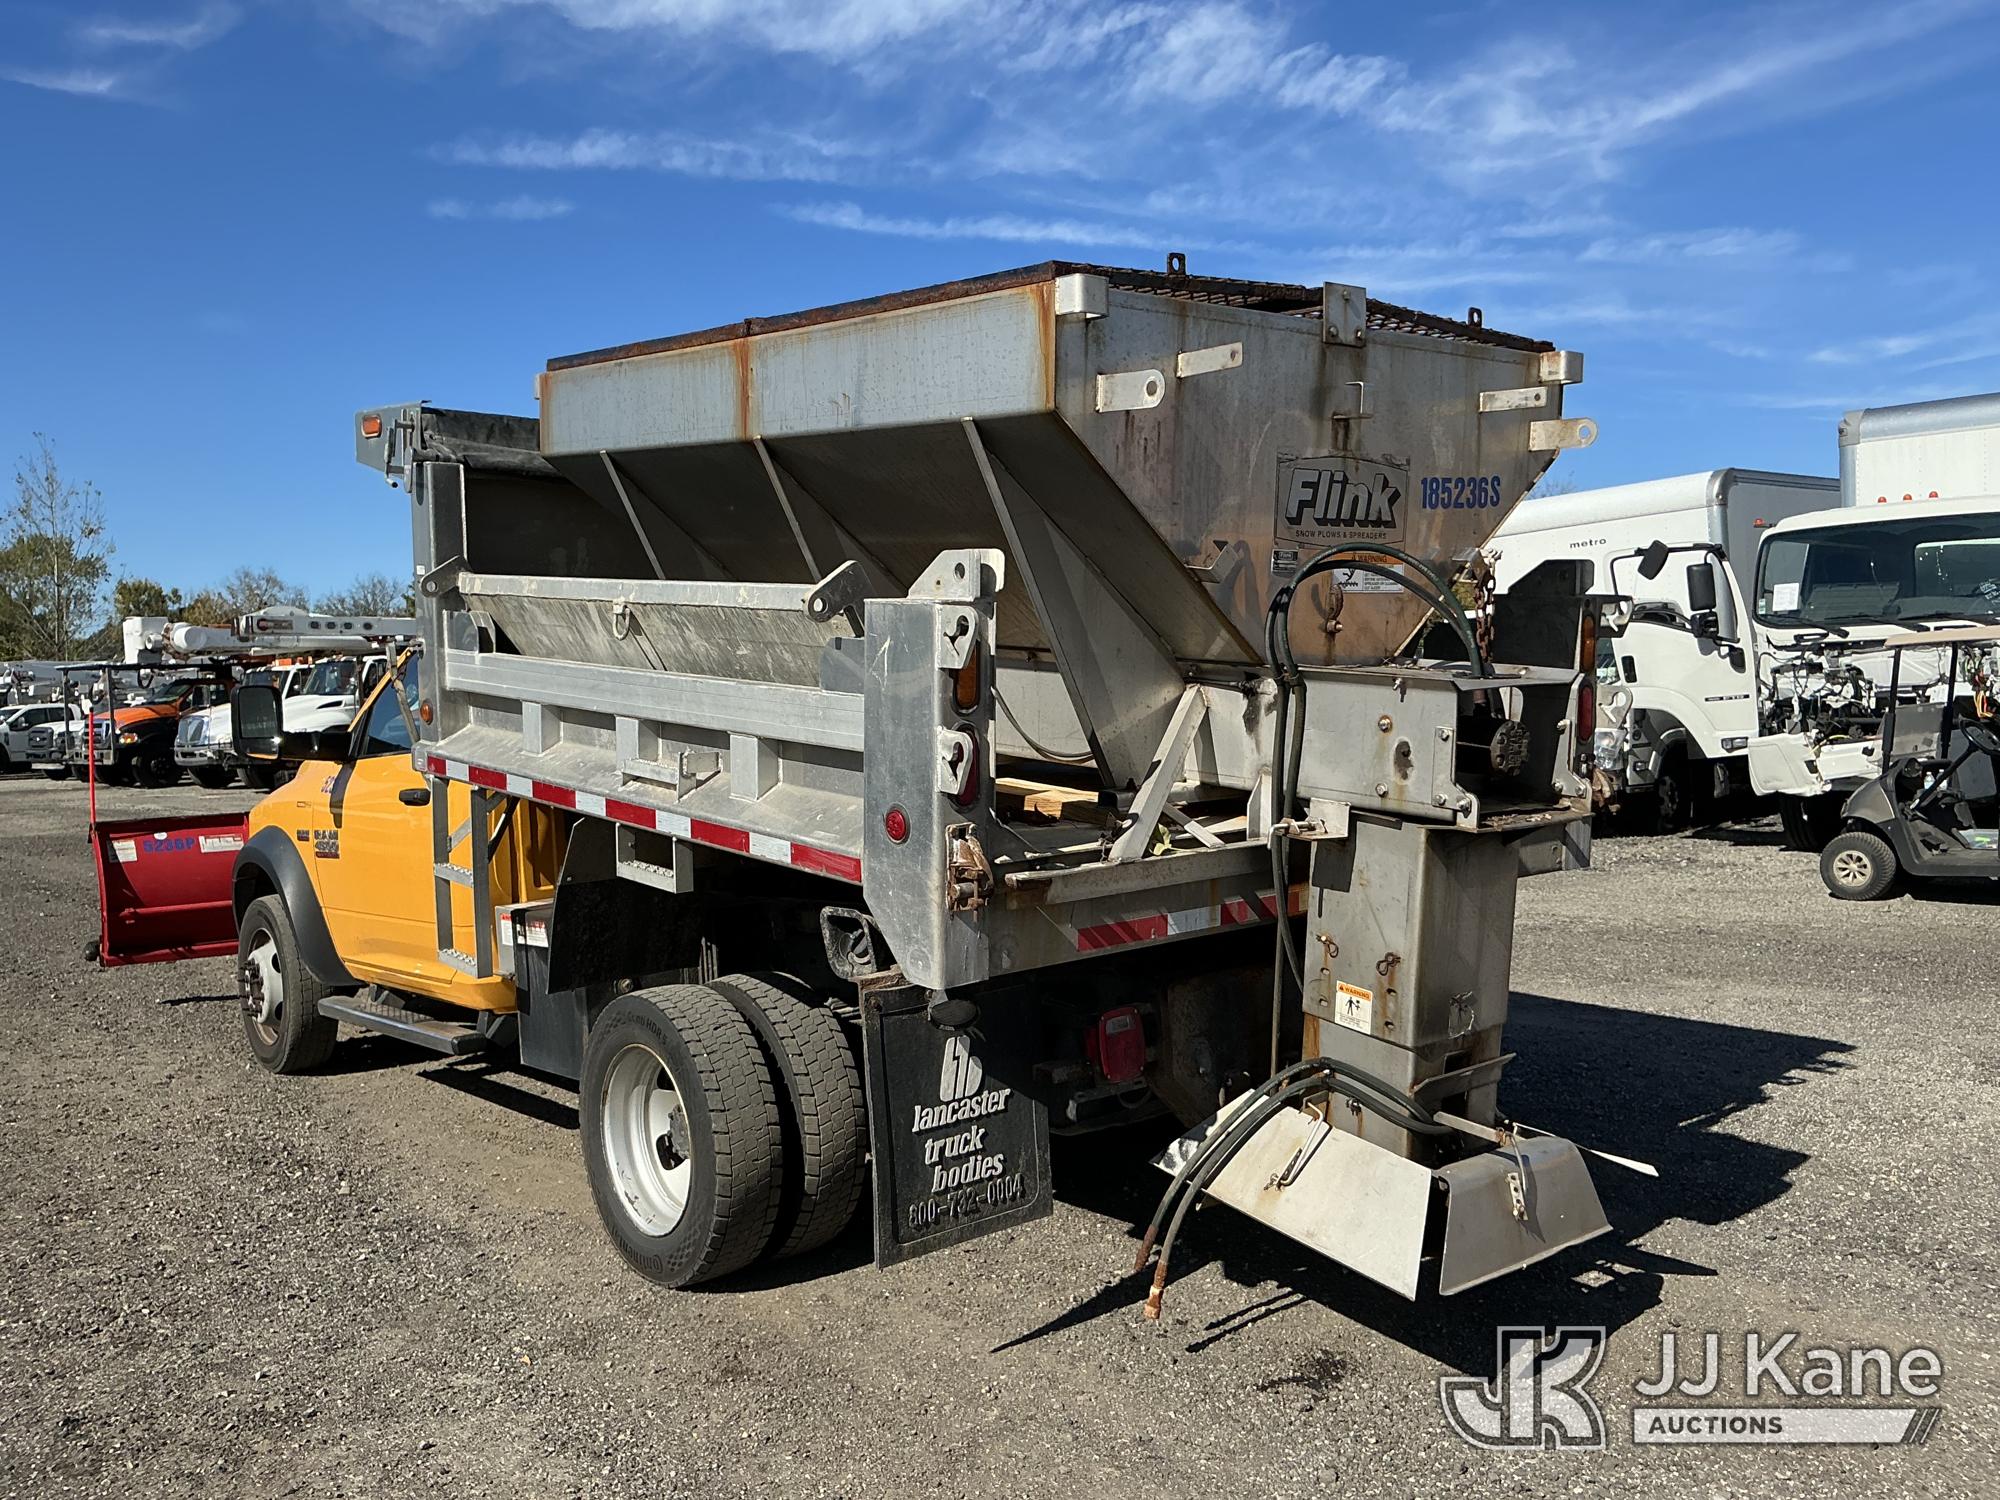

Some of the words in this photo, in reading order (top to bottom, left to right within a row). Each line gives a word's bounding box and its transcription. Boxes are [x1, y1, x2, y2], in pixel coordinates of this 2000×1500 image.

[1285, 467, 1402, 529] Flink
[1420, 475, 1501, 510] 185236S
[1295, 529, 1316, 538] SNOW
[1317, 530, 1341, 538] PLOWS
[1342, 531, 1347, 539] &
[1348, 531, 1387, 540] SPREADERS
[1569, 538, 1607, 549] metro
[1345, 986, 1370, 999] WARNING
[911, 1088, 1011, 1132] lancaster
[924, 1124, 985, 1165] truck
[931, 1153, 1004, 1193] bodies
